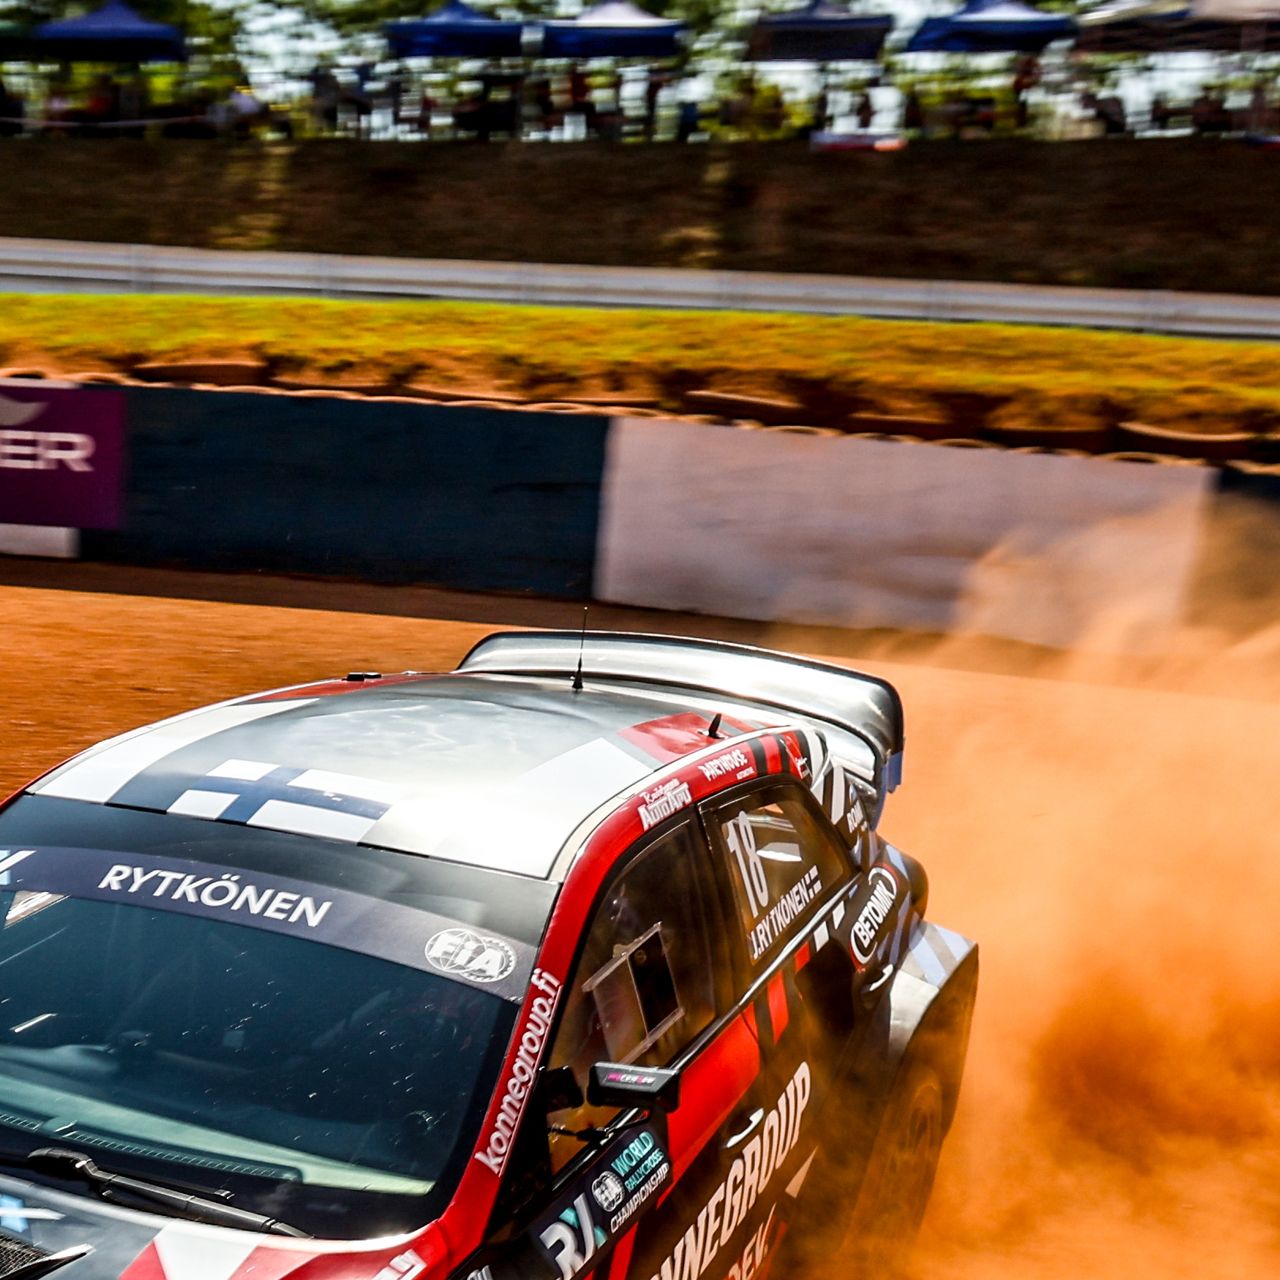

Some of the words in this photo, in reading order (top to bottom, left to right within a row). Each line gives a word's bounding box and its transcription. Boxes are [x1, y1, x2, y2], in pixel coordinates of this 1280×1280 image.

[97, 865, 332, 928] RYTKÖNEN
[726, 810, 768, 918] 18
[474, 969, 563, 1177] konnegroup.fi
[611, 1131, 654, 1177] WORLD
[610, 1162, 670, 1234] CHAMPIONSHIP
